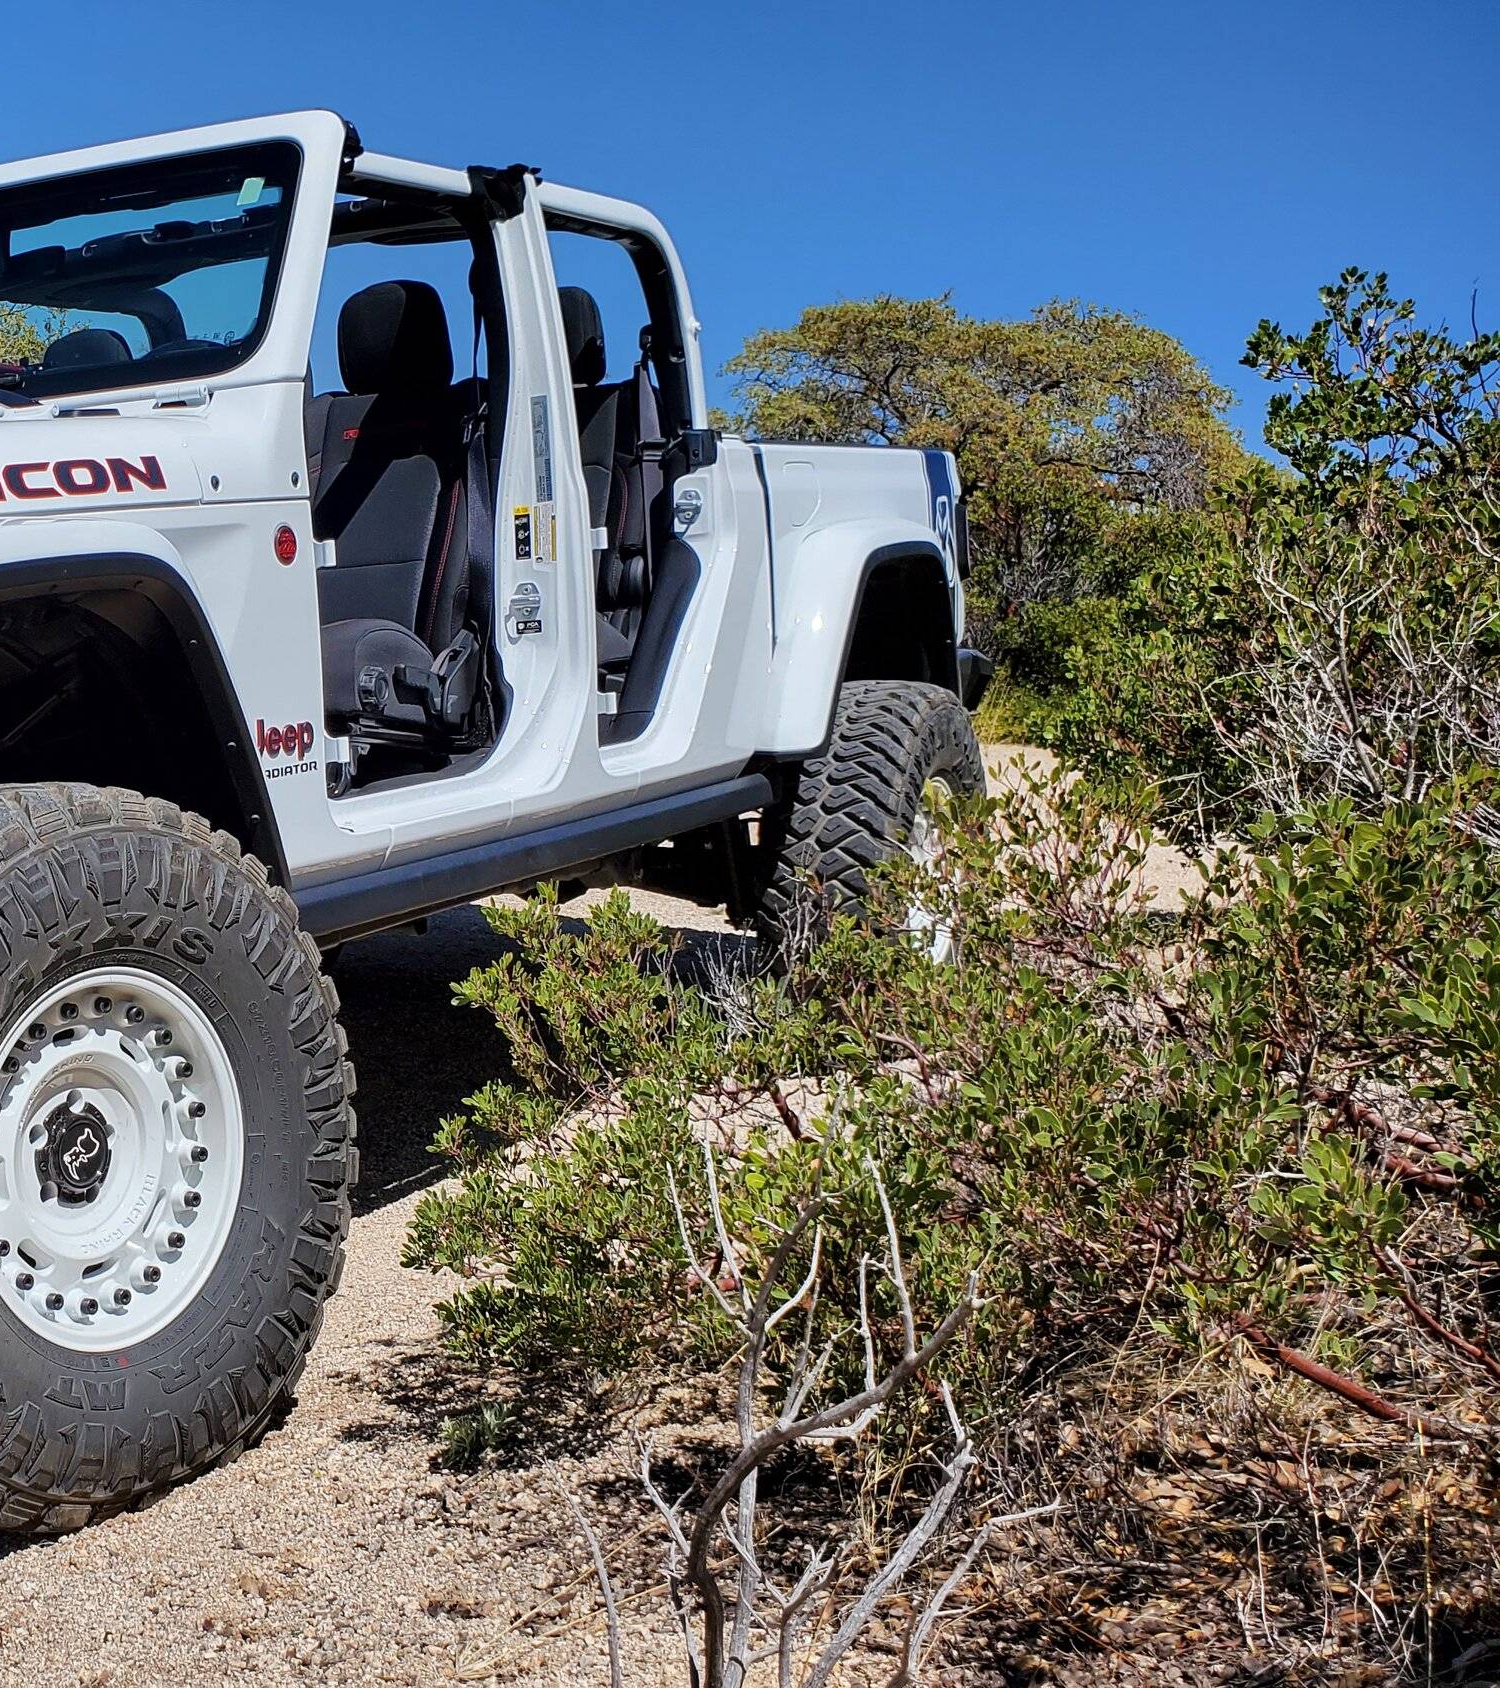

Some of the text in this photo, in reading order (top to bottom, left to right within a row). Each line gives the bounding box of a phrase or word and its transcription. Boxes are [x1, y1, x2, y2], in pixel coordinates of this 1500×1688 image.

[256, 719, 314, 761] Jeep
[264, 761, 318, 779] ADIATOR
[123, 1173, 156, 1228] BLACK
[44, 1375, 128, 1411] MT
